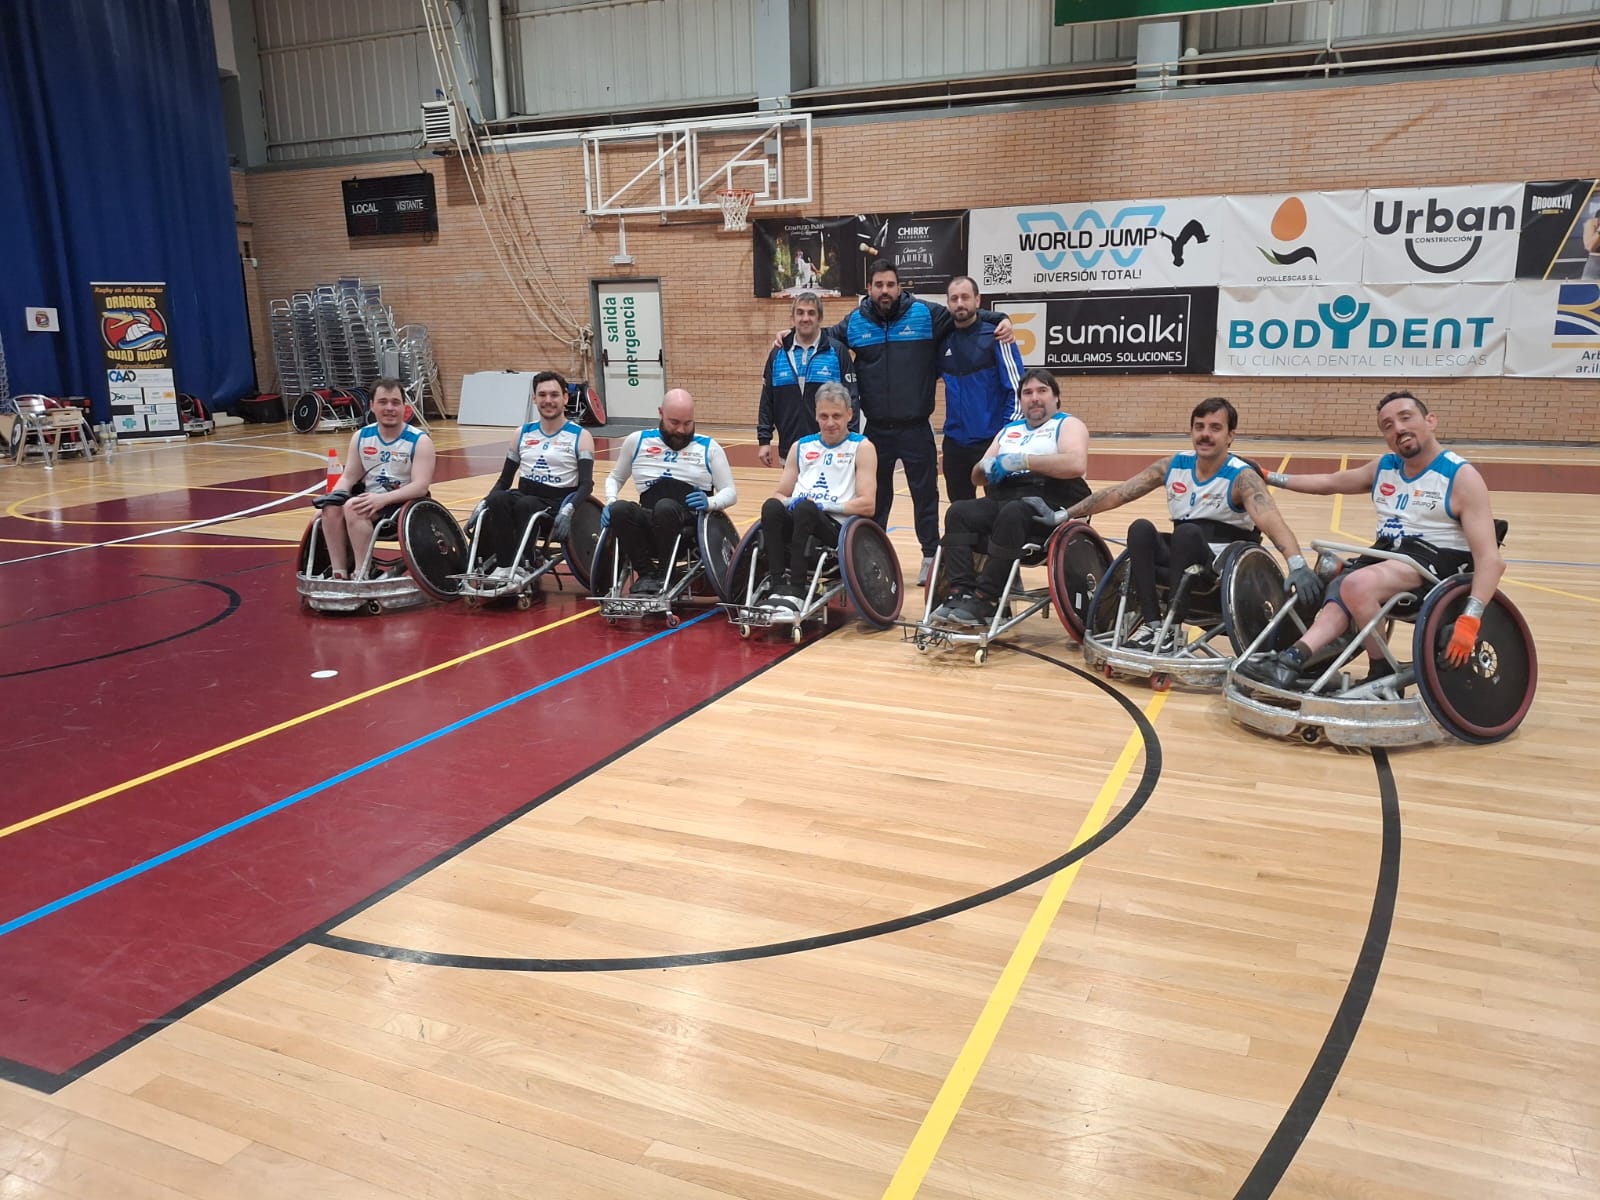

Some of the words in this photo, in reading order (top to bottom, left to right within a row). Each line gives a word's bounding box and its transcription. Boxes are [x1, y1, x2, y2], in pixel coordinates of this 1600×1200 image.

[352, 202, 379, 214] LOCAL
[396, 199, 424, 212] VISITANTE
[1531, 194, 1572, 211] BROOKLYN
[1374, 198, 1515, 235] Urban
[897, 226, 930, 236] CHIRRY
[1019, 229, 1093, 252] WORLD
[1098, 227, 1158, 248] JUMP
[1415, 235, 1472, 243] CONSTRUCCIÓN
[1033, 269, 1097, 283] ¡DIVERSIÓN
[1101, 269, 1142, 281] TOTAL!
[105, 295, 157, 309] DRAGONES
[602, 297, 619, 343] salida
[1049, 314, 1184, 346] sumialki
[620, 296, 640, 387] emergencia
[107, 350, 134, 361] QUAD
[137, 349, 168, 361] RUGBY
[1047, 353, 1112, 364] ALQUILAMOS
[1116, 351, 1183, 362] SOLUCIONES
[1228, 355, 1247, 366] TU
[1317, 355, 1376, 366] DENTAL
[1383, 355, 1404, 366] EN
[1411, 354, 1487, 366] ILLESCAS
[542, 442, 550, 450] 6
[380, 450, 391, 463] 32
[663, 451, 678, 463] 22
[823, 453, 833, 465] 13
[1190, 492, 1196, 506] 8
[1395, 494, 1409, 510] 10
